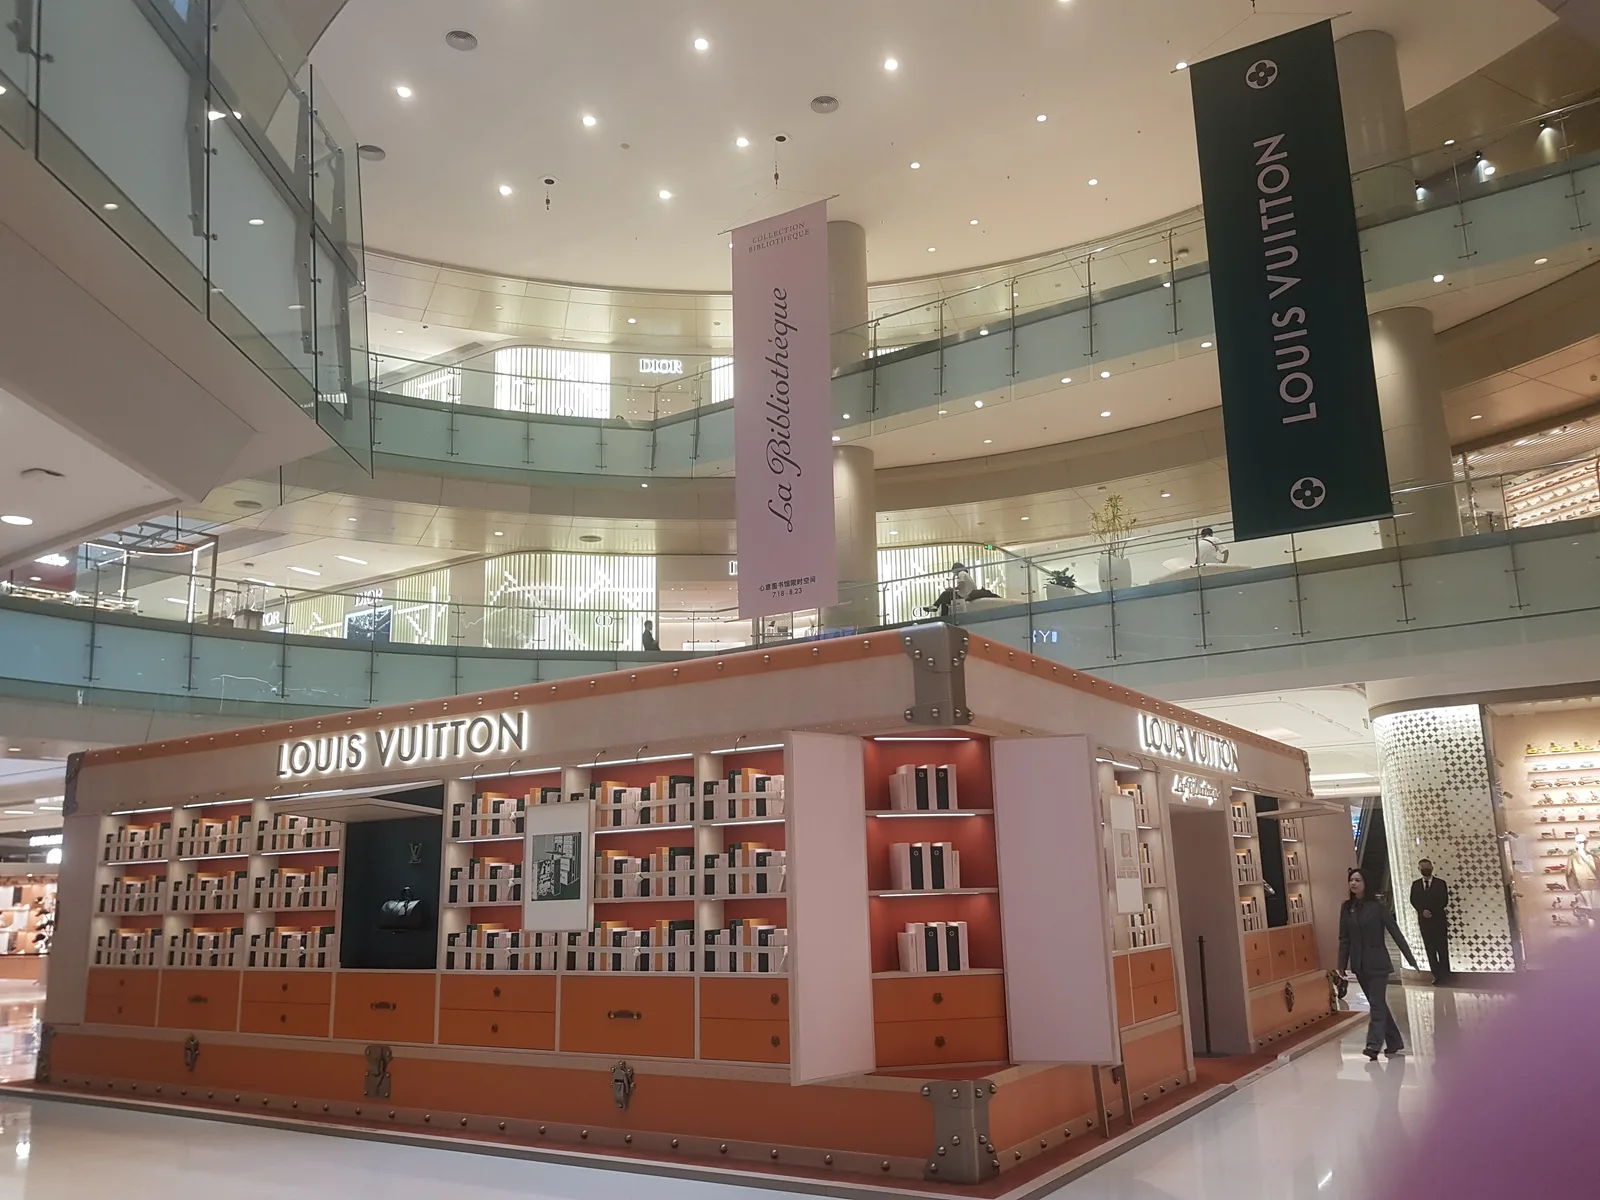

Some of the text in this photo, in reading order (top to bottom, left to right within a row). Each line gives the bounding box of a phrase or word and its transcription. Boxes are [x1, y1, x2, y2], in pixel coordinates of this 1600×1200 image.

[752, 221, 806, 244] COLLECTION
[1253, 132, 1318, 424] LOUIS VUITTON
[639, 358, 683, 374] DIOR
[767, 482, 794, 533] La
[276, 711, 528, 779] LOUIS VUITTON
[1138, 712, 1240, 773] LOUIS VUITTON
